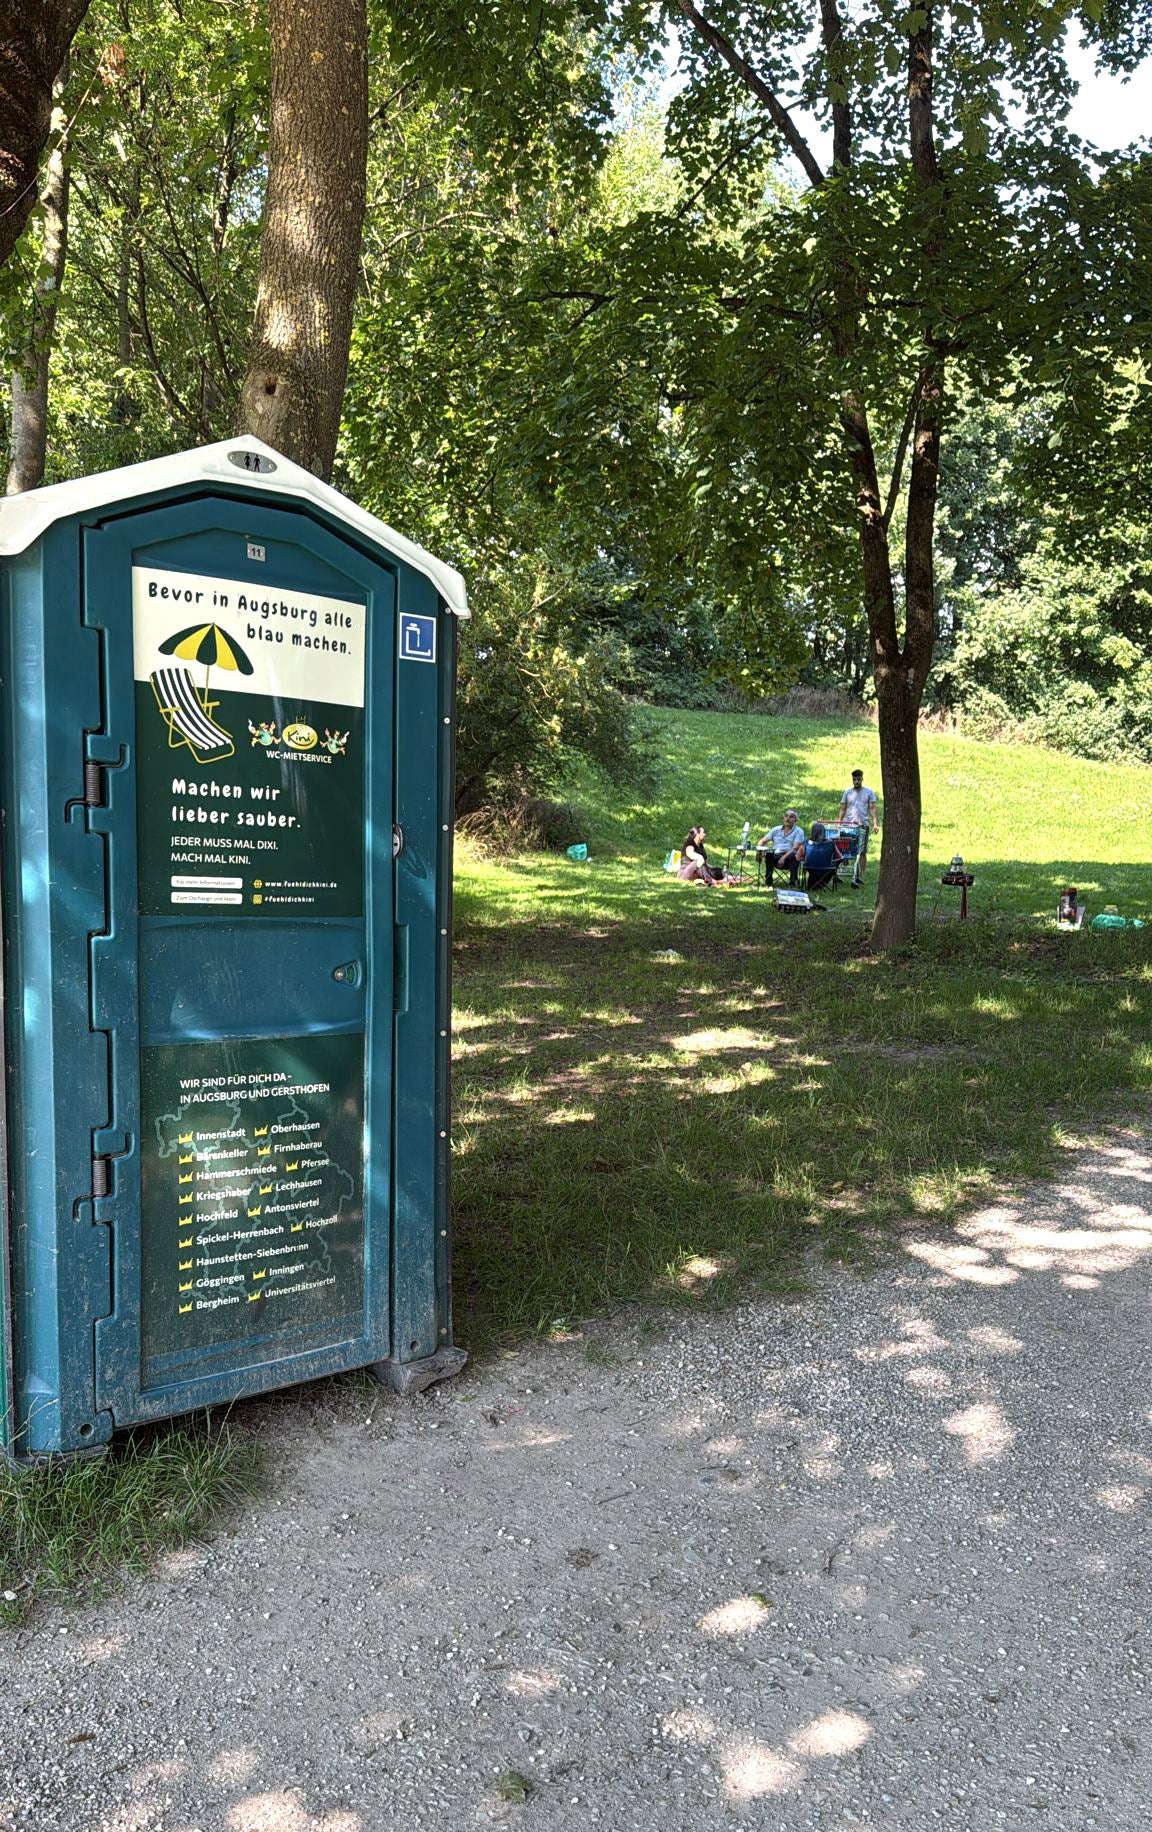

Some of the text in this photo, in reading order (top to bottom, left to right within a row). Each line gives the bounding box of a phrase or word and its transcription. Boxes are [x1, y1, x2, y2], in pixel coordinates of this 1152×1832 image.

[251, 547, 261, 558] 11
[148, 581, 352, 628] Bevor in Augsburg alle
[247, 623, 352, 655] blau machen.
[287, 729, 312, 743] Kini
[265, 750, 332, 764] WC-MIETSERVICE
[171, 778, 281, 801] Machen wir
[171, 805, 301, 829] lieber sauber.
[170, 836, 279, 850] JEDER MUSS MAL DIXI.
[170, 852, 251, 865] MACH MAL KINI.
[179, 1078, 201, 1089] WIR
[201, 1076, 226, 1088] SIND
[227, 1073, 247, 1086] FÜR
[248, 1073, 272, 1084] DICH
[180, 1083, 330, 1104] IN AUGSBURG UND GERSTHOFEN
[196, 1121, 320, 1141] Innenstadt Oberhausen
[196, 1140, 323, 1162] Bärenkeller Firnhaberau
[196, 1158, 330, 1181] Hammerschmiede Pfersee
[196, 1178, 322, 1202] Kriegshaber Lechhausen
[196, 1197, 320, 1223] Hochfeld Antonsviertel
[196, 1214, 338, 1247] Spickel-Herrenbach Hochzoll
[196, 1242, 309, 1267] Haunstetten-Siebenbrunn
[196, 1262, 305, 1290] Göggingen Inningen
[196, 1275, 336, 1311] Bergheim Universitätsviertel
